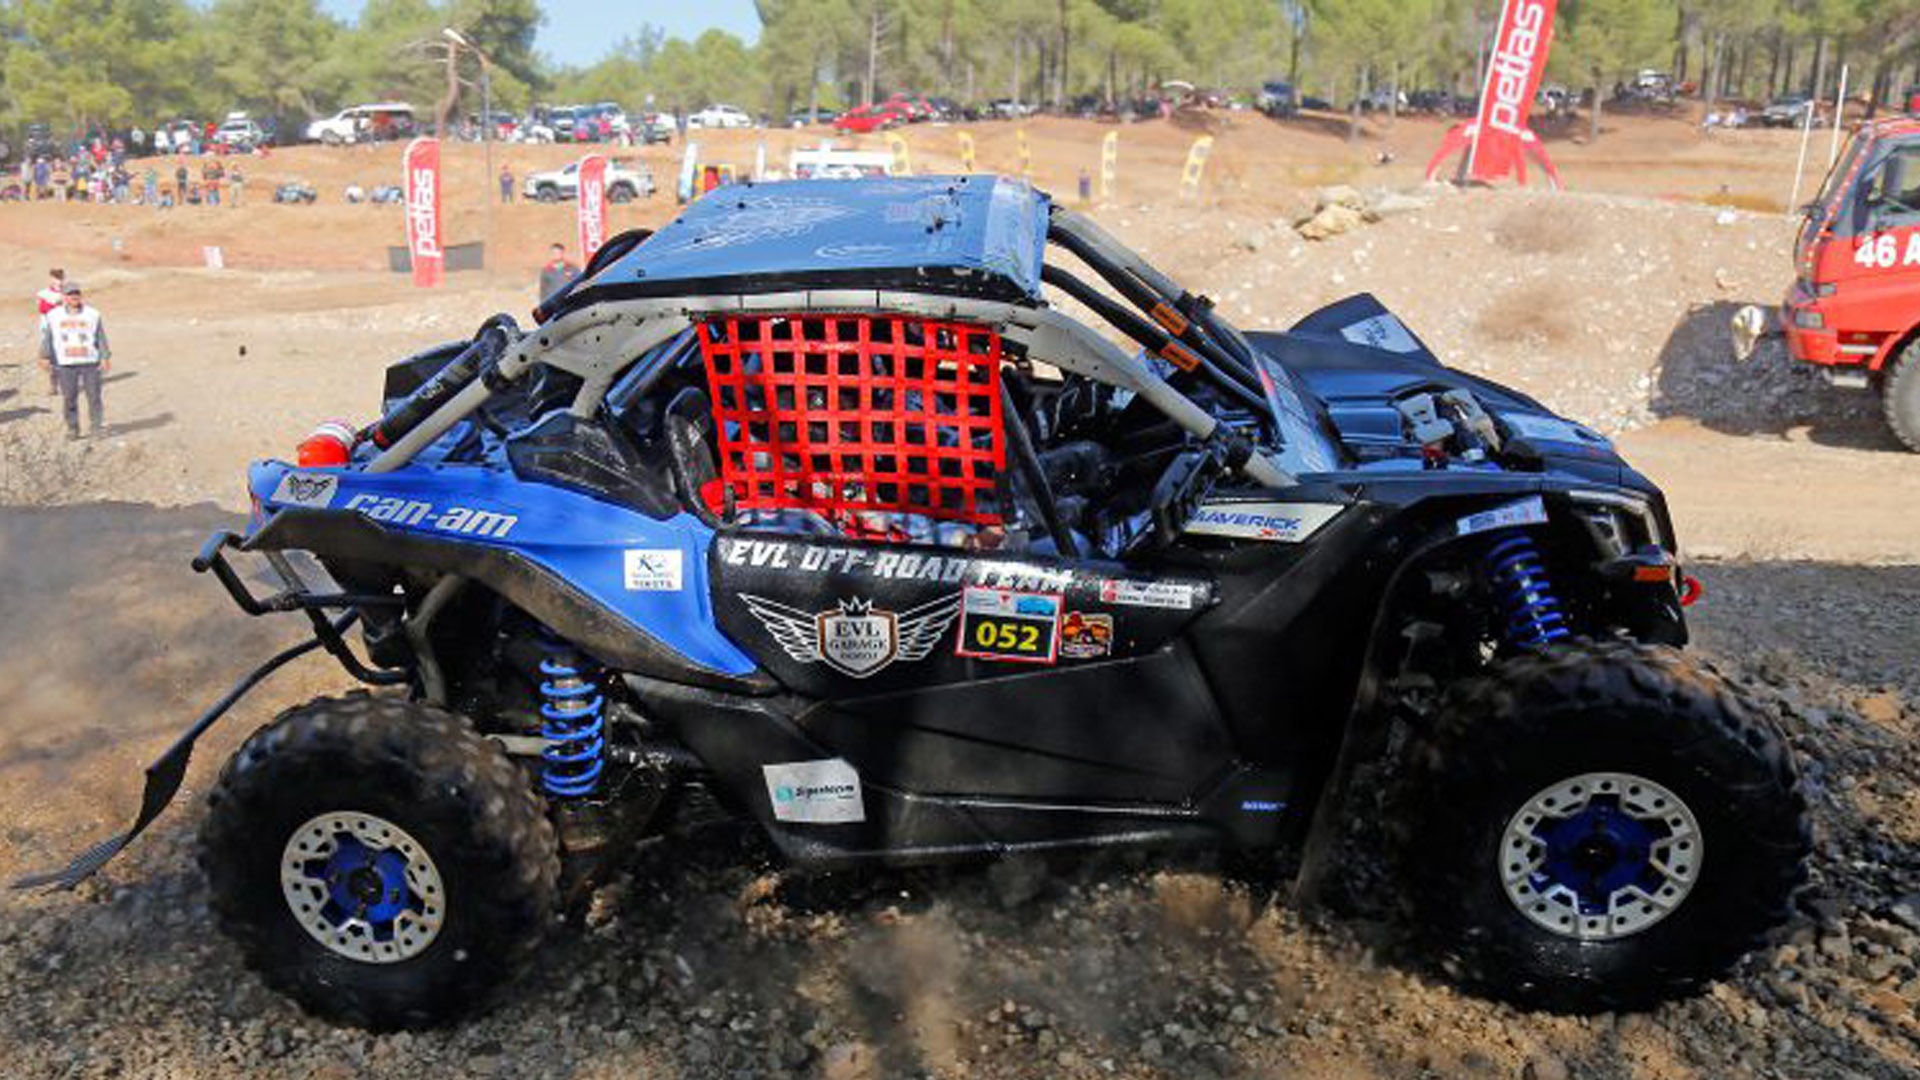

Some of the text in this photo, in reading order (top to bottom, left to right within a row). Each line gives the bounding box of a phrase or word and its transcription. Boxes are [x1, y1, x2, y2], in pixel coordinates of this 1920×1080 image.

[1488, 0, 1545, 135] petlas
[411, 168, 441, 258] petlas
[1854, 233, 1897, 268] 46
[344, 492, 519, 538] can-am
[726, 539, 790, 569] EVL
[798, 546, 969, 582] OFF-ROAD
[834, 620, 881, 637] EVL
[975, 620, 1040, 652] 052
